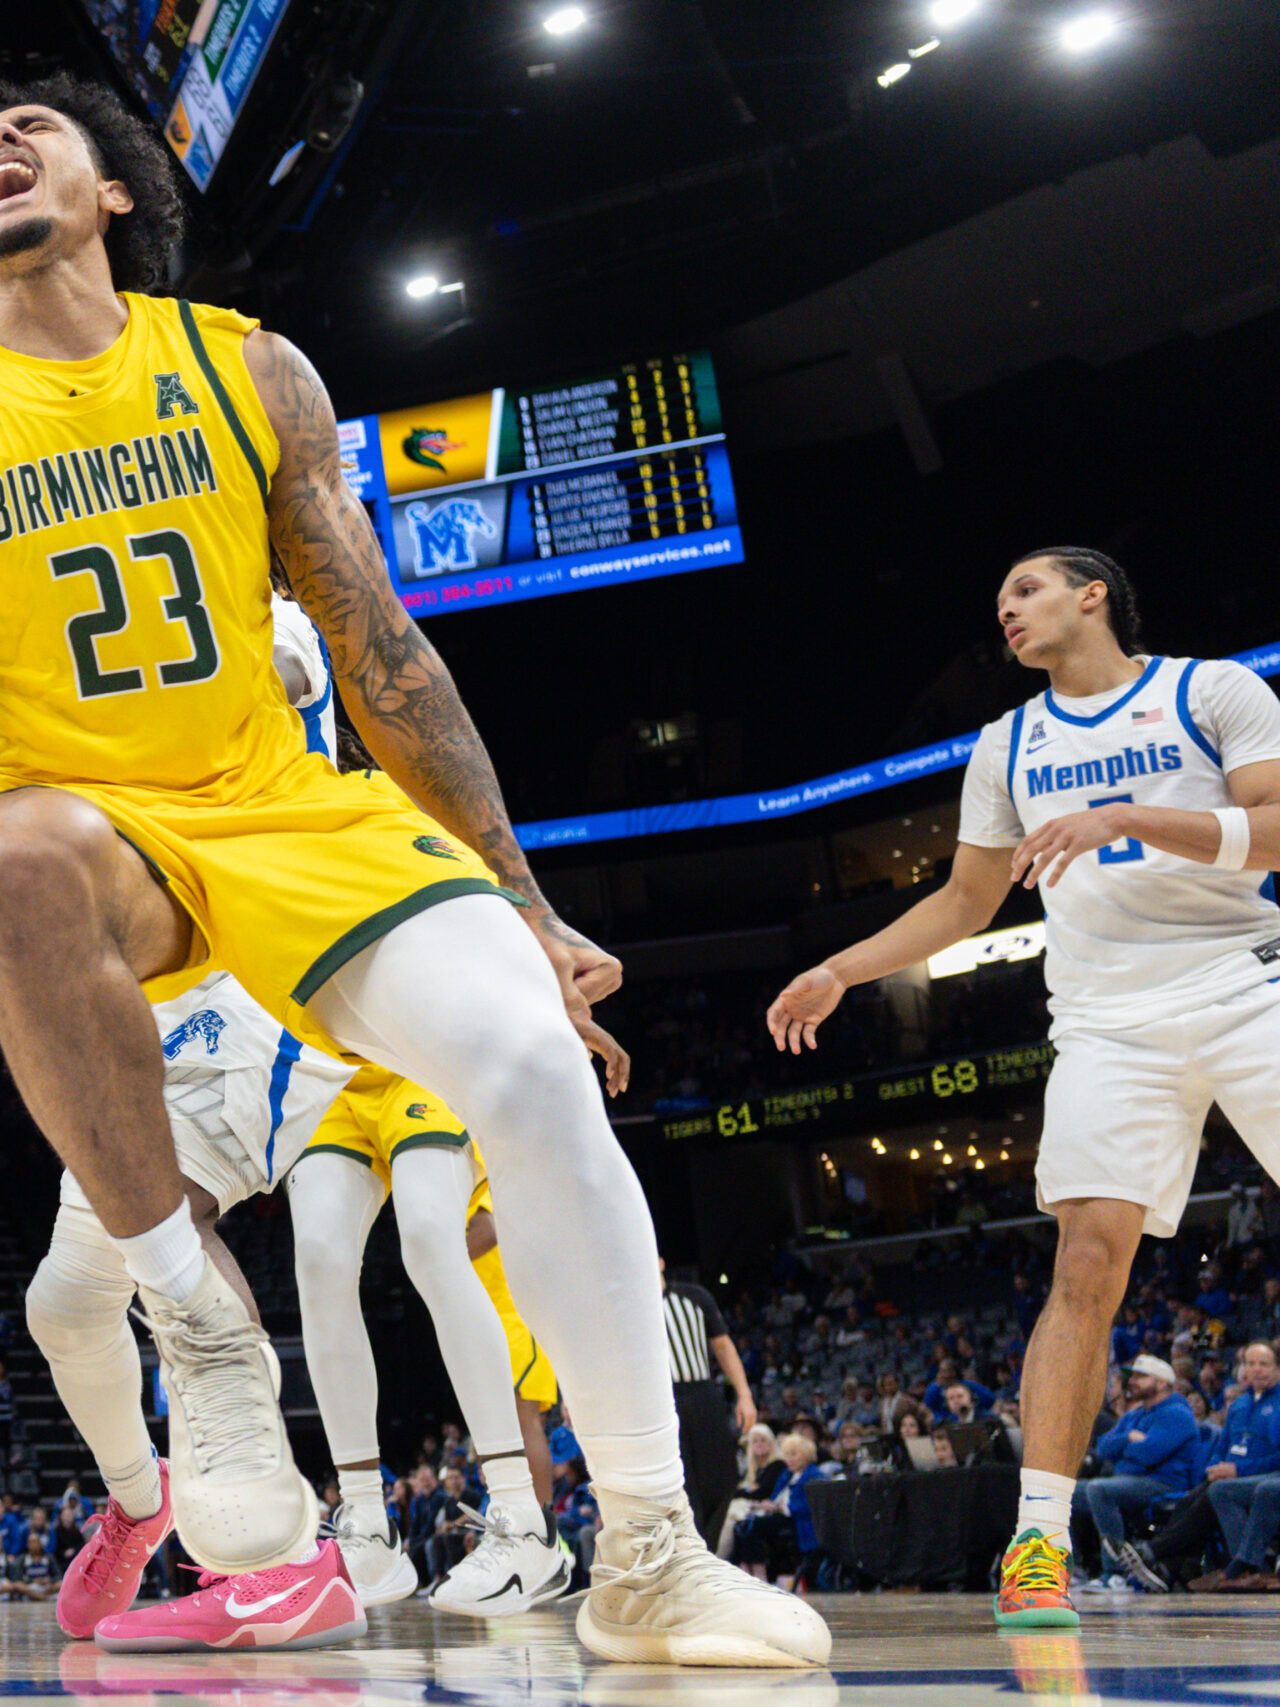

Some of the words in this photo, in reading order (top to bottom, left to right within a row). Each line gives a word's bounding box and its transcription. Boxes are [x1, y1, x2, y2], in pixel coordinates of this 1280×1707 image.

[569, 537, 732, 580] conwayservices.net
[47, 527, 222, 701] 23
[757, 791, 800, 813] Learn
[884, 748, 950, 778] Compete
[1023, 742, 1183, 799] Memphis
[985, 1044, 1055, 1073] TIMEOUT
[716, 1101, 761, 1138] 61
[878, 1075, 926, 1101] GUEST
[930, 1059, 981, 1099] 68
